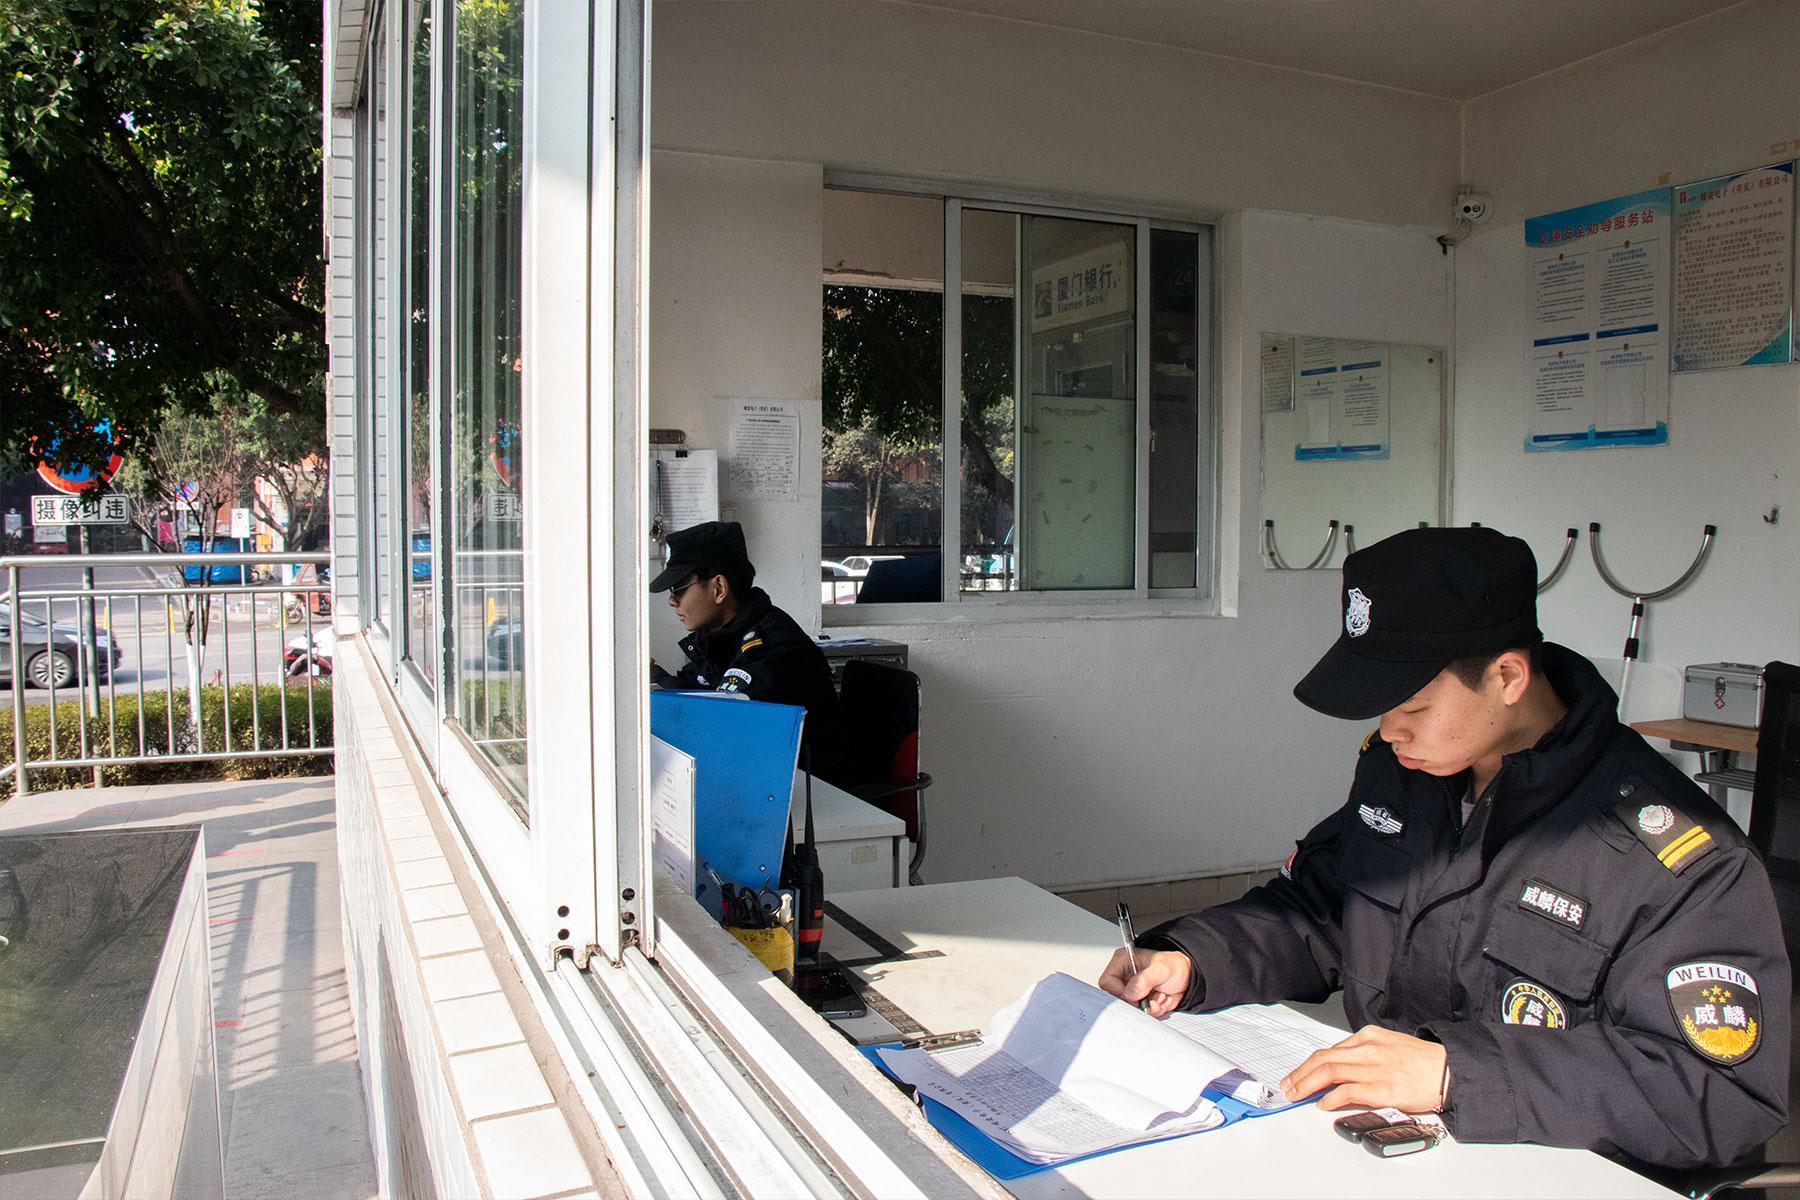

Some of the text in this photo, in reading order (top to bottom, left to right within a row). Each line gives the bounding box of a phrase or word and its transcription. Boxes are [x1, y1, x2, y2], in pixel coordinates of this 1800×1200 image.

[1057, 263, 1113, 301] 厦门银行
[37, 499, 125, 520] 摄像纠违
[1676, 966, 1747, 986] WEILIN
